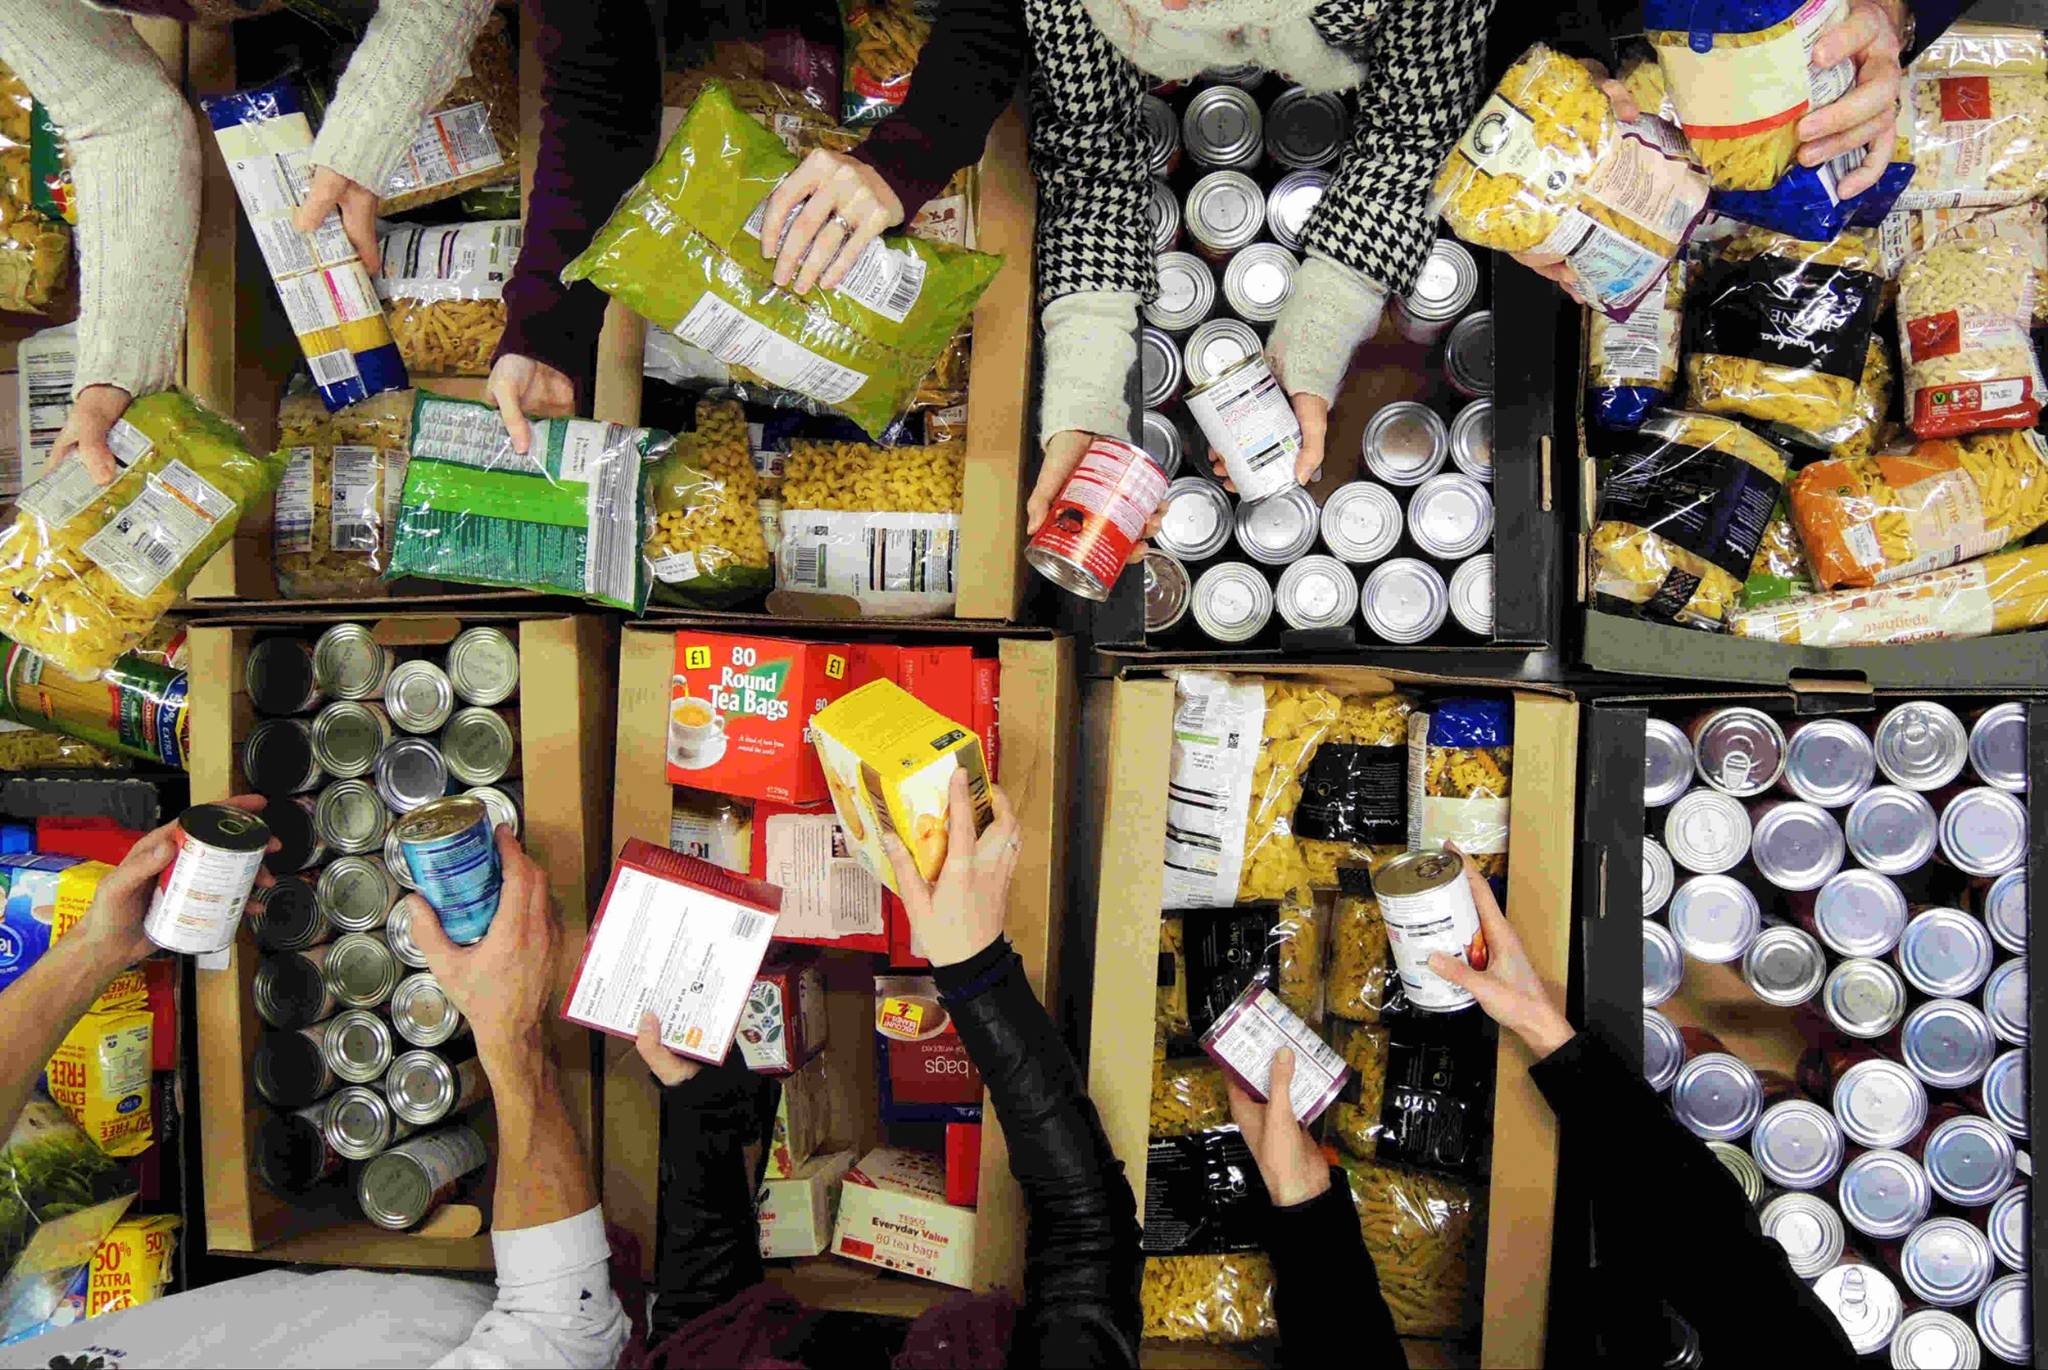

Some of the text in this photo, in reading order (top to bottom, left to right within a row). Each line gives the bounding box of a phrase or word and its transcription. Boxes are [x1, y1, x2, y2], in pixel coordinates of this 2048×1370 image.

[691, 651, 704, 665] £1
[732, 647, 756, 667] 80
[829, 659, 841, 675] £1
[722, 667, 777, 692] Round
[709, 685, 788, 721] Tea Bags
[163, 727, 173, 756] EXTRA
[51, 1059, 86, 1088] FREE
[924, 1056, 969, 1078] bags
[53, 1088, 86, 1105] EXTRA
[872, 1216, 949, 1244] Everyday Value
[94, 1241, 131, 1272] 50%
[893, 1237, 909, 1251] tea
[913, 1242, 939, 1259] bags
[93, 1272, 131, 1288] EXTRA
